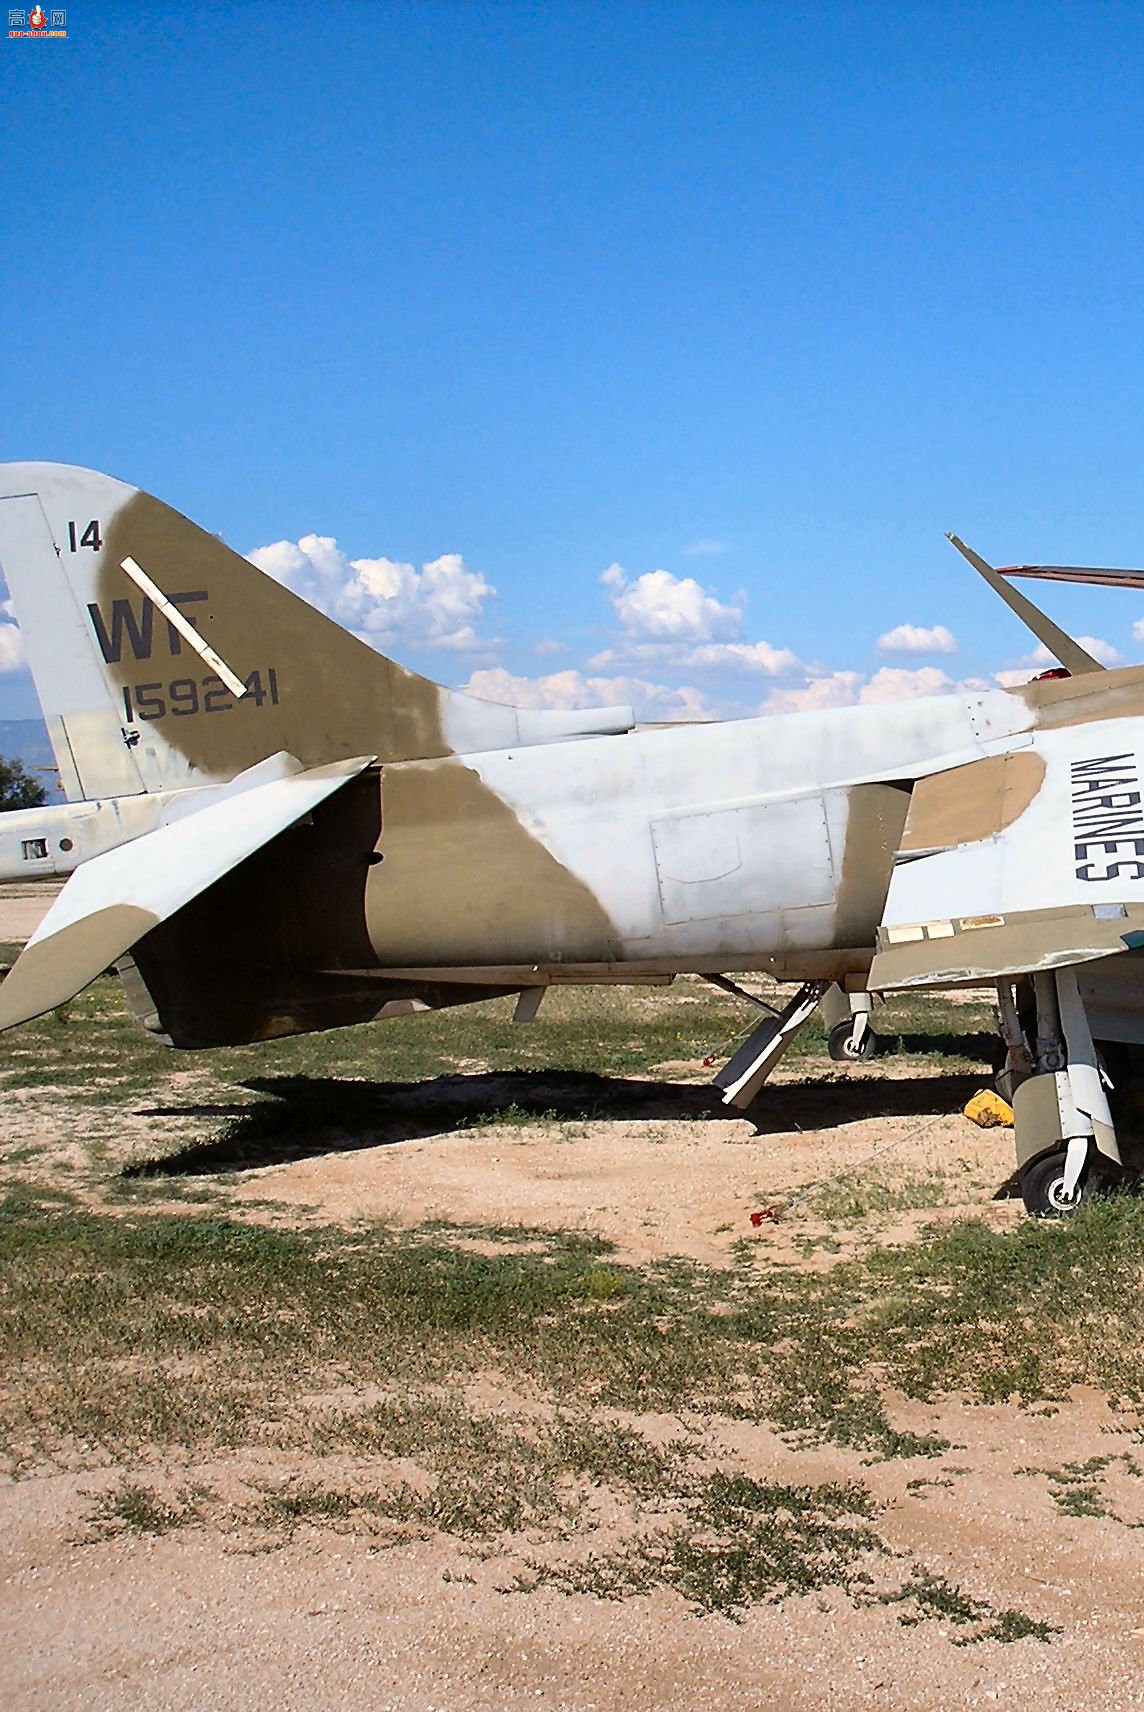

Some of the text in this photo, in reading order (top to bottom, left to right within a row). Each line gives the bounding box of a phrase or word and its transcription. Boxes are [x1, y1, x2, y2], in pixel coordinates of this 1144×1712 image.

[68, 520, 103, 553] 14
[87, 590, 209, 665] WF
[122, 668, 280, 723] 159241
